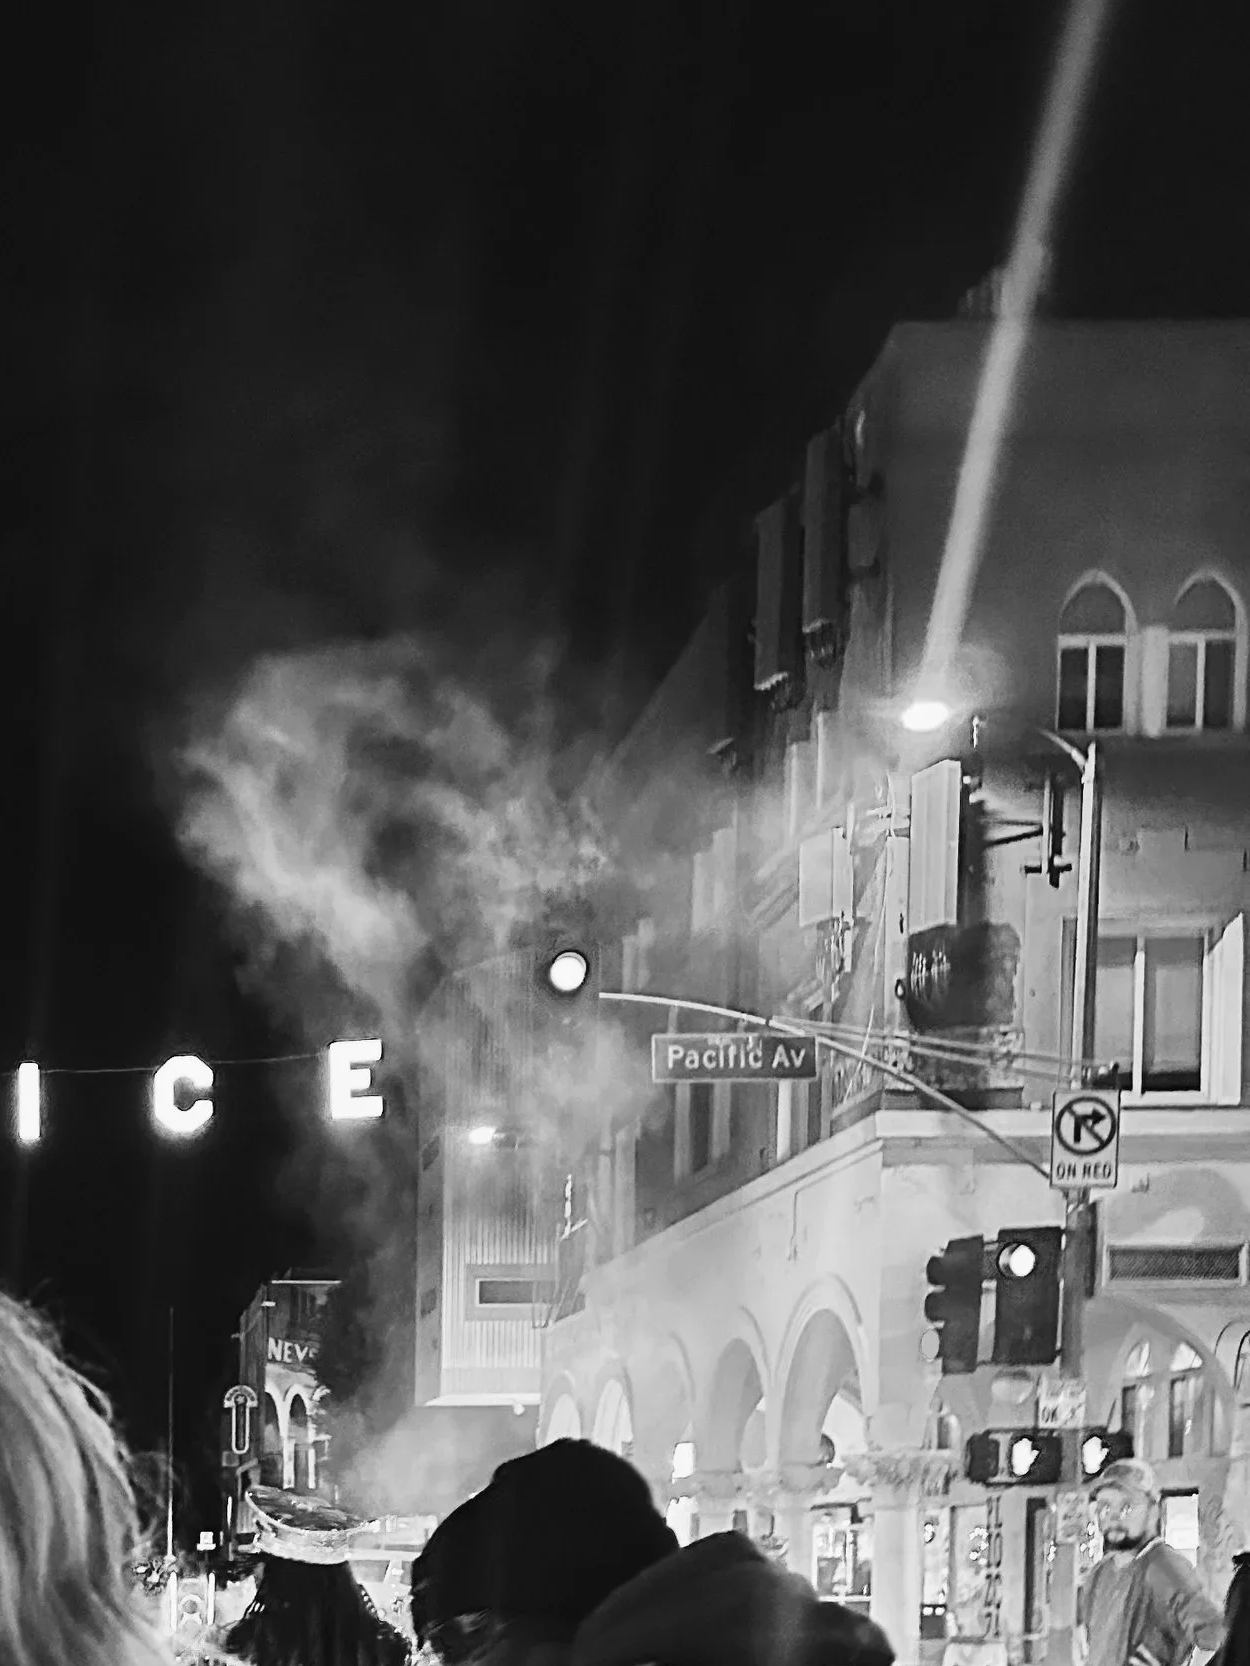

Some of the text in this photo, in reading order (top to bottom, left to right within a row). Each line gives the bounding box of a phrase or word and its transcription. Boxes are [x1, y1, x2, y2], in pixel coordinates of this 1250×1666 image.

[667, 1043, 807, 1070] Pacific Av
[1056, 1162, 1112, 1179] ON RED
